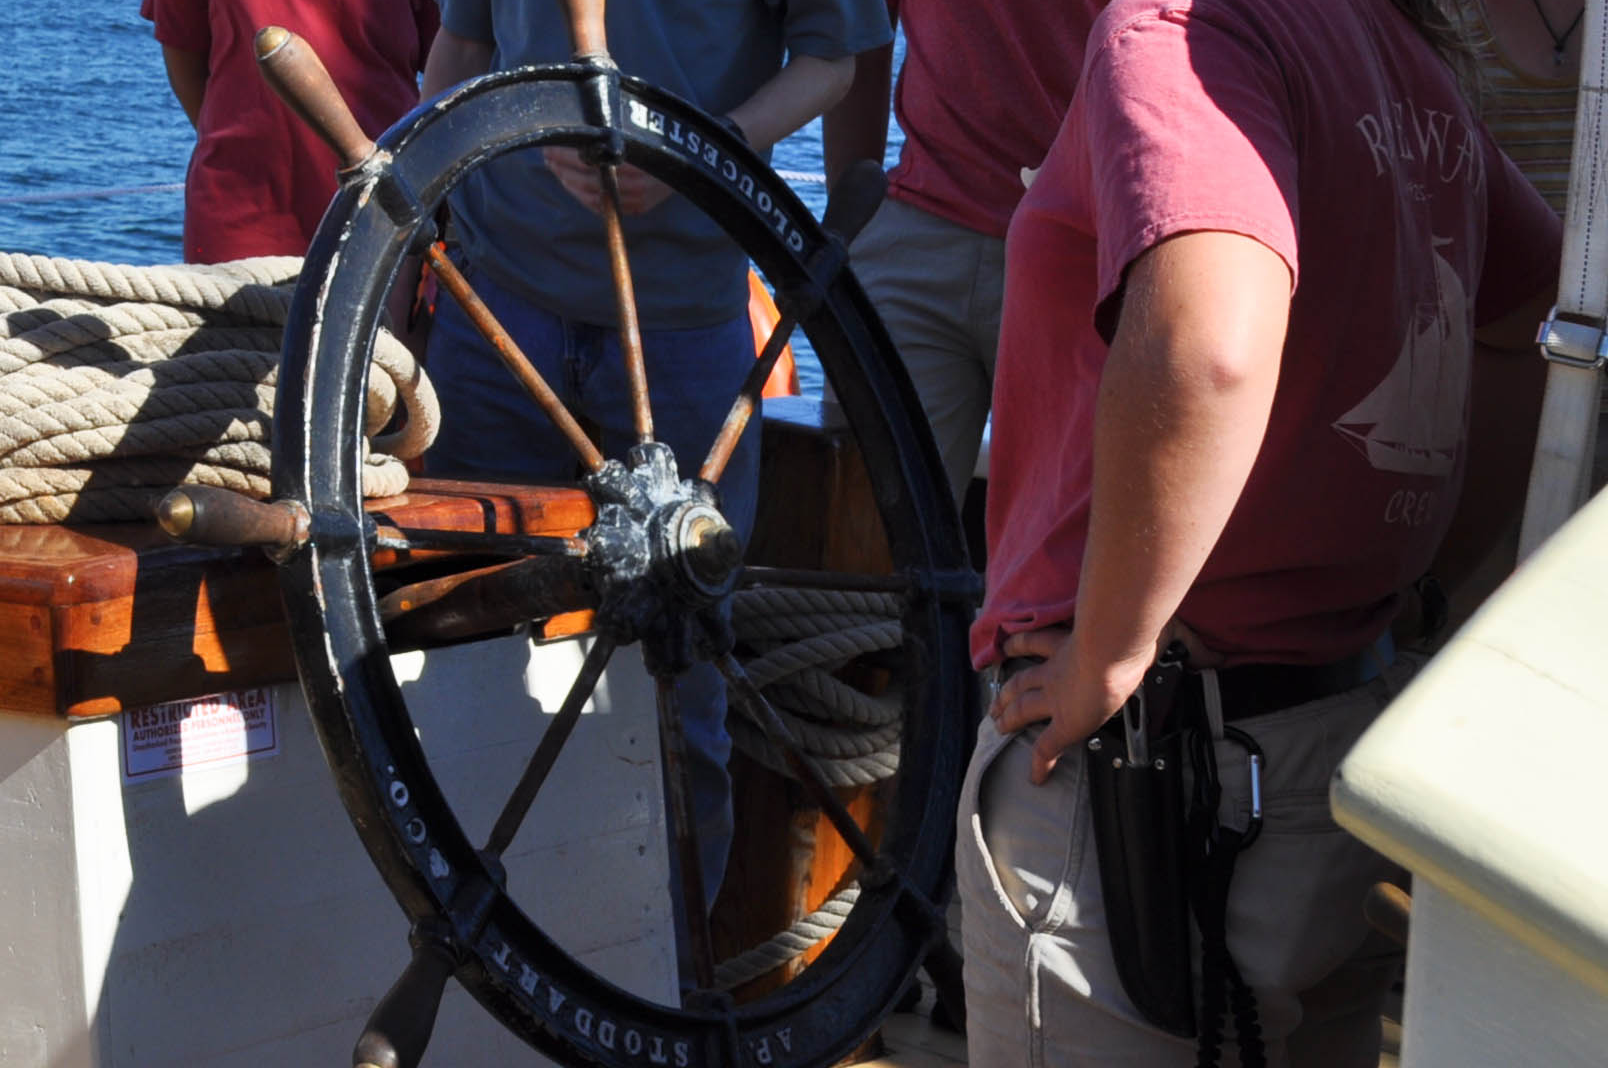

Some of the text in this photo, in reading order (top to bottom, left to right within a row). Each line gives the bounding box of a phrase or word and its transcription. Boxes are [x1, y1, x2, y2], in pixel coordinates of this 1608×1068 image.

[628, 98, 806, 254] GLOUCESTER
[130, 696, 221, 729] RESTRICTED
[134, 721, 189, 742] AUTHORIZED
[244, 708, 265, 721] ONLY
[489, 940, 691, 1067] STODDART
